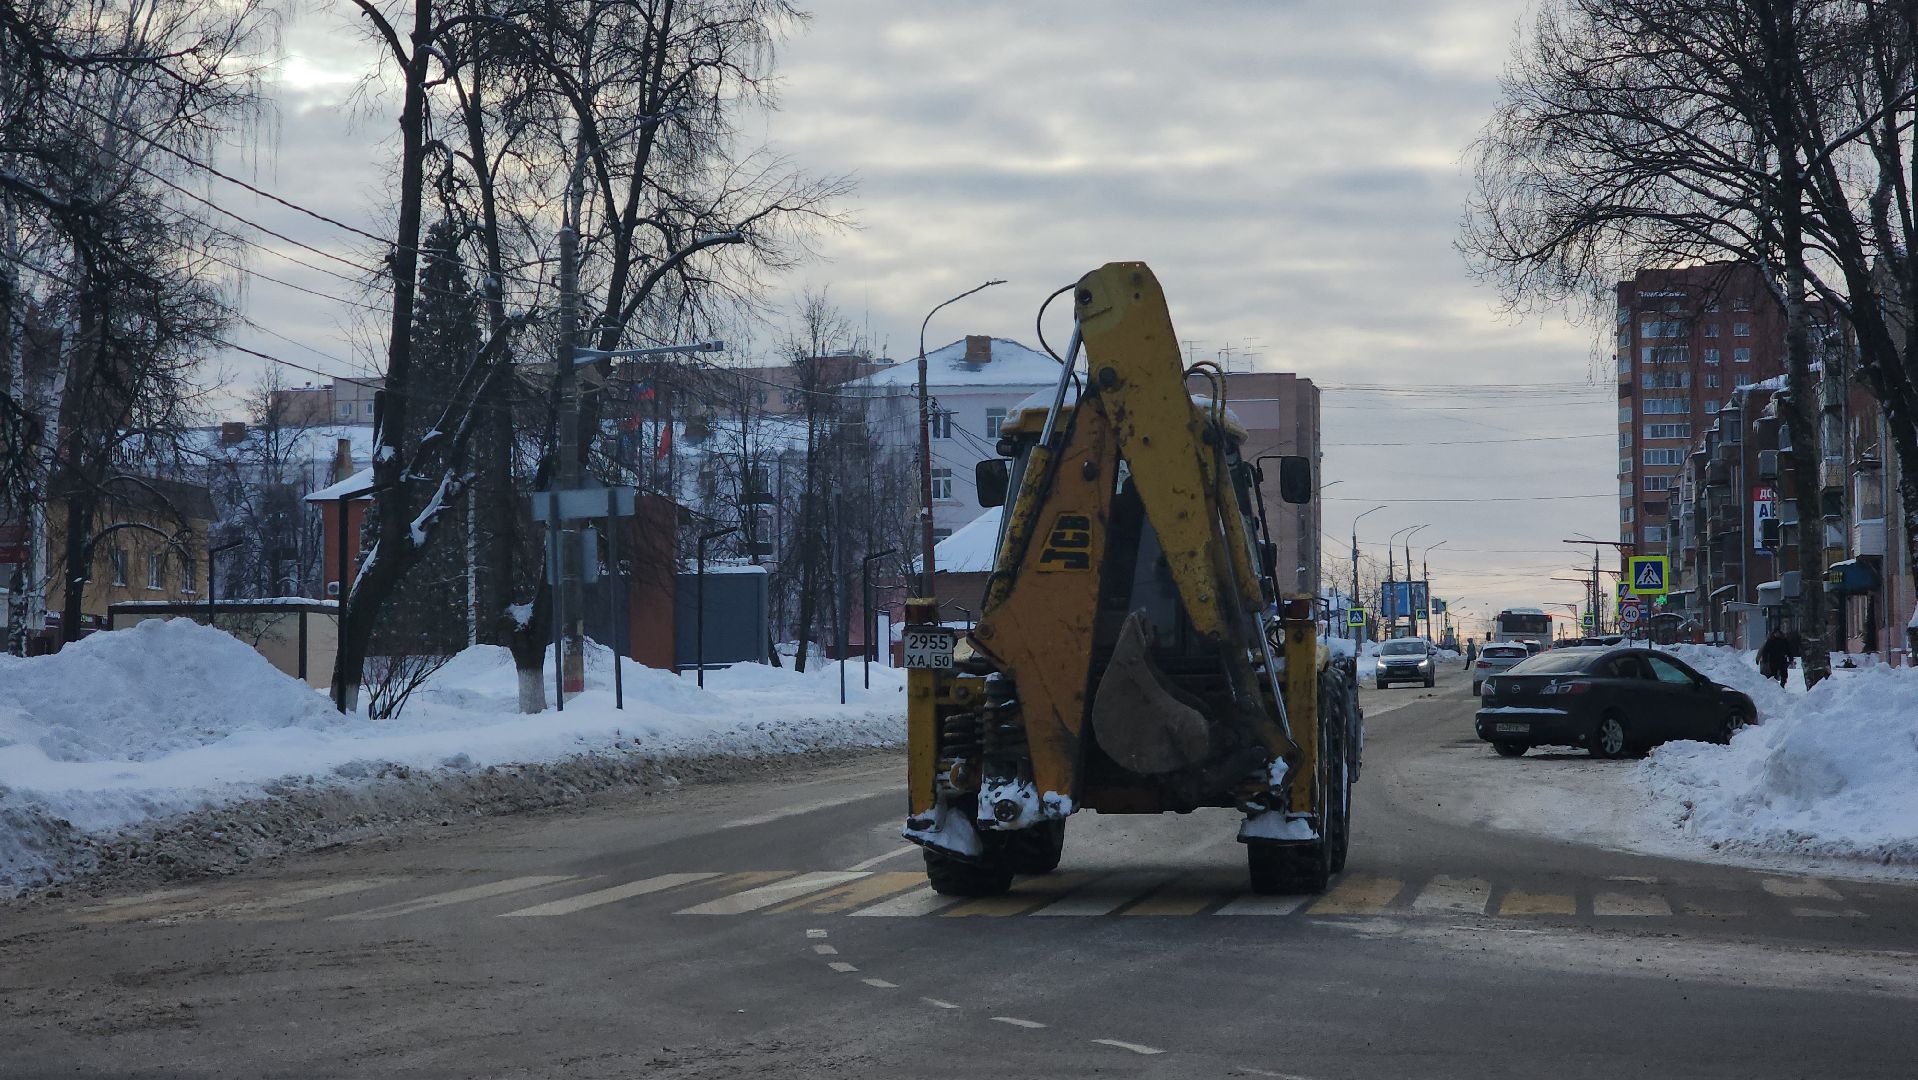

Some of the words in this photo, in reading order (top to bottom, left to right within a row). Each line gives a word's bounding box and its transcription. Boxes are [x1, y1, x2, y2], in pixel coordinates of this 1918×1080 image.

[1040, 515, 1090, 569] JCB
[1625, 610, 1637, 618] 40
[910, 635, 948, 649] 2955
[907, 655, 925, 666] ХА
[934, 656, 949, 666] 50
